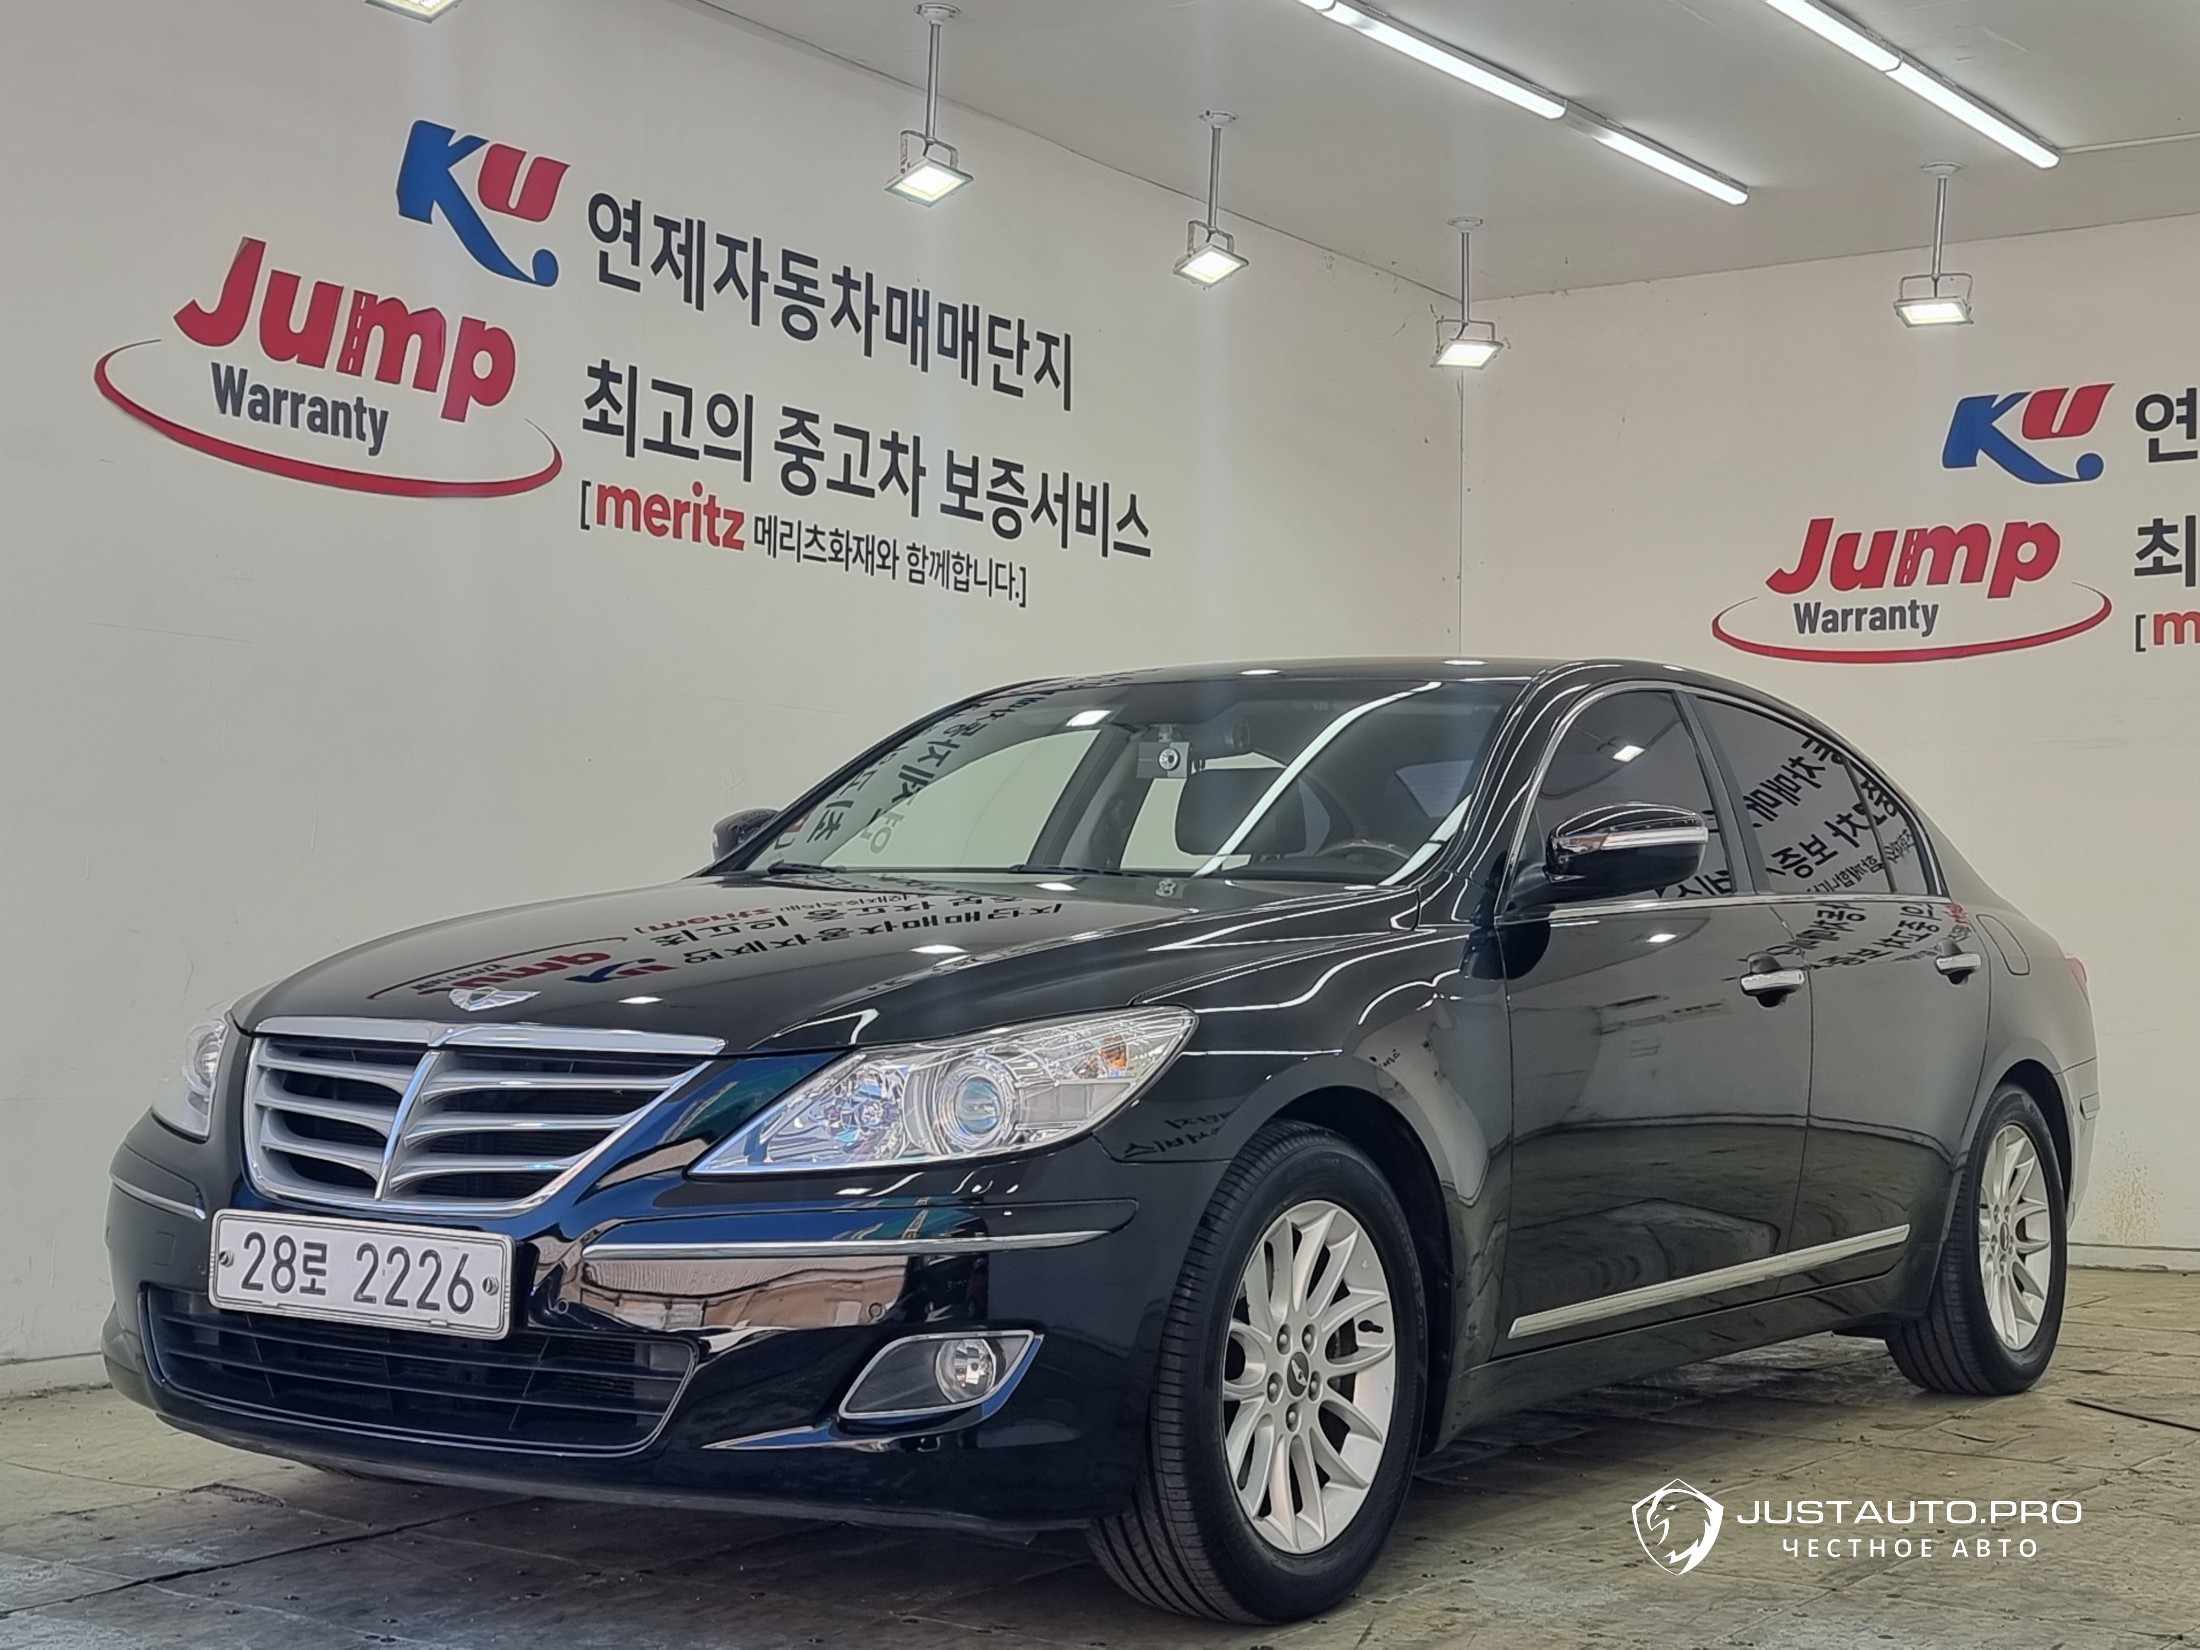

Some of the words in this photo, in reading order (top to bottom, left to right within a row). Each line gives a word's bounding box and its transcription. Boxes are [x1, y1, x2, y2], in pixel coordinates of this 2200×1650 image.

[173, 236, 516, 422] Jump
[587, 192, 1072, 411] 연제자동차매매단지
[211, 362, 388, 456] Warranty
[582, 359, 753, 482] 최고의
[774, 406, 926, 518] 중고차
[940, 449, 1152, 559] 보증서비스
[753, 515, 900, 579] 메리츠화재와
[1766, 518, 2061, 599] Jump
[1793, 600, 1939, 637] Warranty
[241, 1231, 328, 1296] 28로
[353, 1242, 474, 1314] 2226
